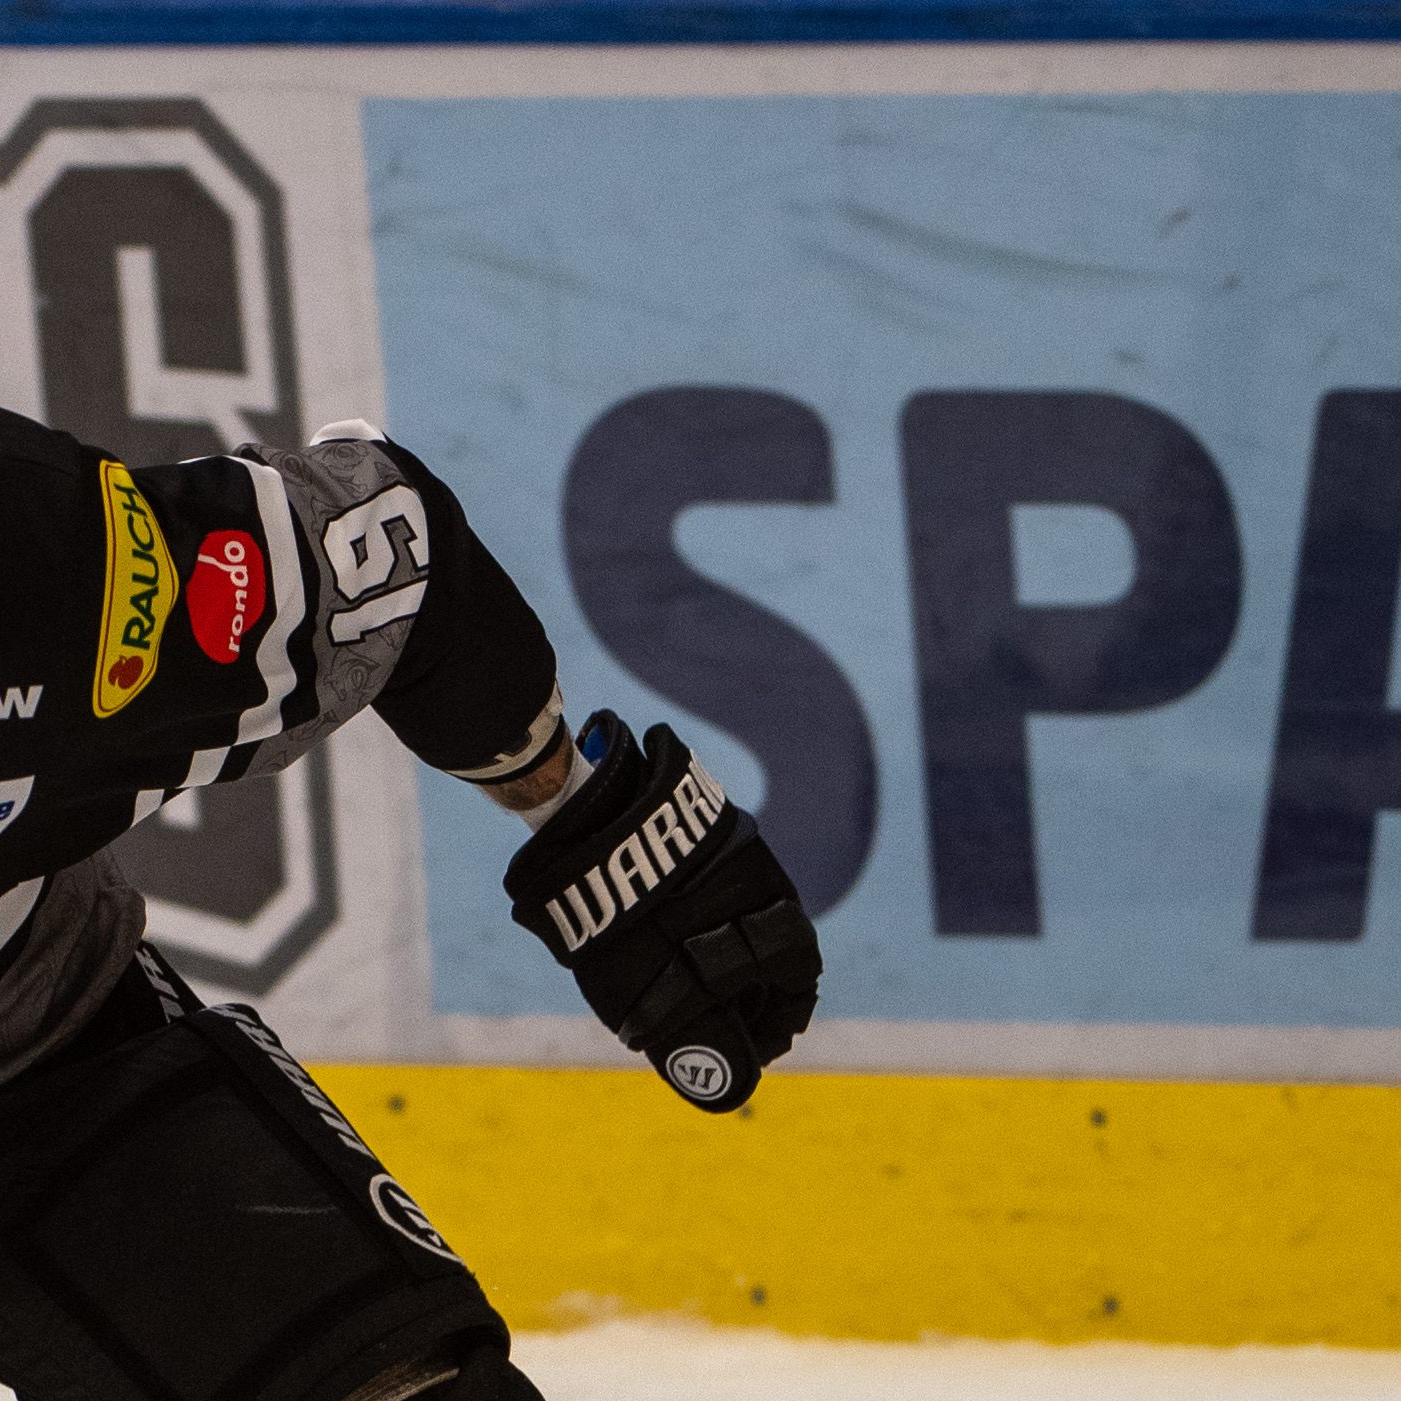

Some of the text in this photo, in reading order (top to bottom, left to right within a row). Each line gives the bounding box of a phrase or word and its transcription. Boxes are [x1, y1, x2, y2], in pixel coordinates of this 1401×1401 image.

[113, 482, 161, 650] RAUCH
[198, 540, 249, 653] rondo
[322, 484, 431, 647] 19
[545, 748, 726, 952] WARRI
